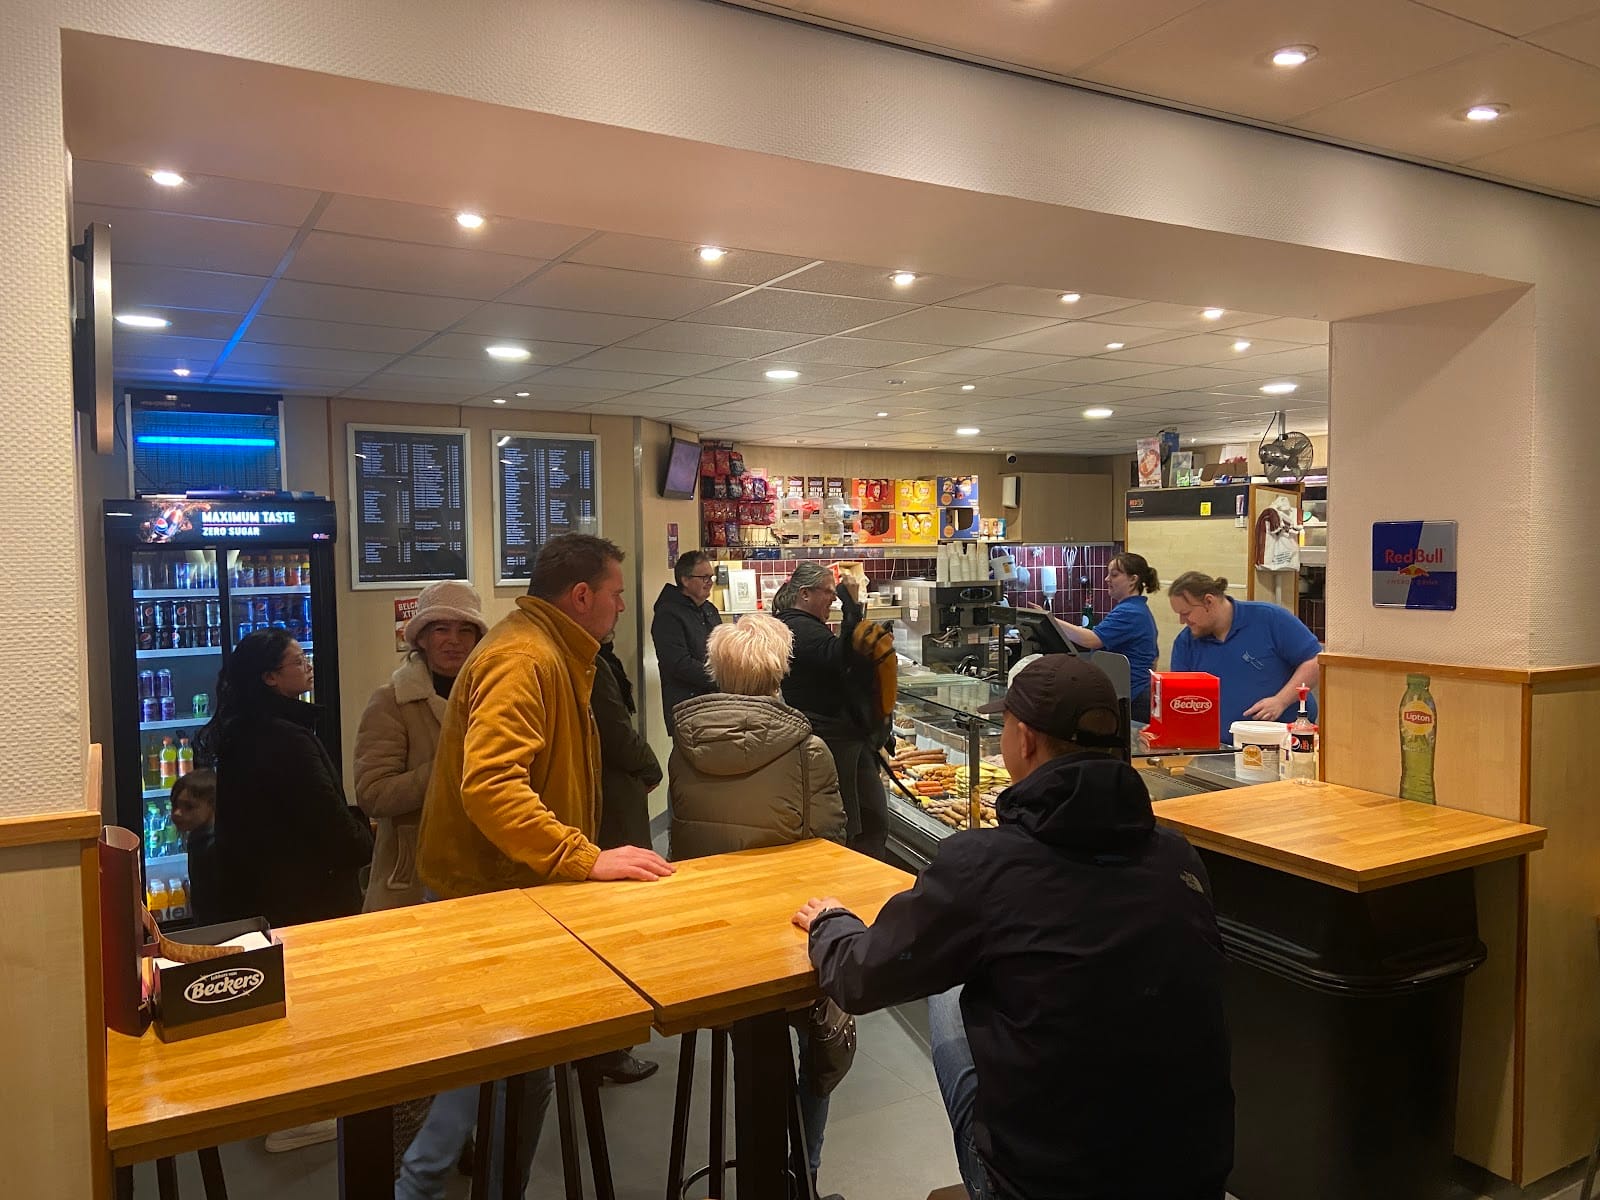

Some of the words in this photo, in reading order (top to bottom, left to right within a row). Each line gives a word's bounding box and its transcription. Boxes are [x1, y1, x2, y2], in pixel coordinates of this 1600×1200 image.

[202, 511, 260, 523] MAXIMUM
[261, 511, 296, 523] TASTE
[202, 527, 226, 536] ZERO
[228, 527, 260, 536] SUGAR
[1385, 548, 1413, 564] Red
[1415, 547, 1443, 564] Bull
[1173, 699, 1210, 711] Beckers
[1405, 712, 1431, 723] Lipton
[191, 973, 260, 1000] Beckers
